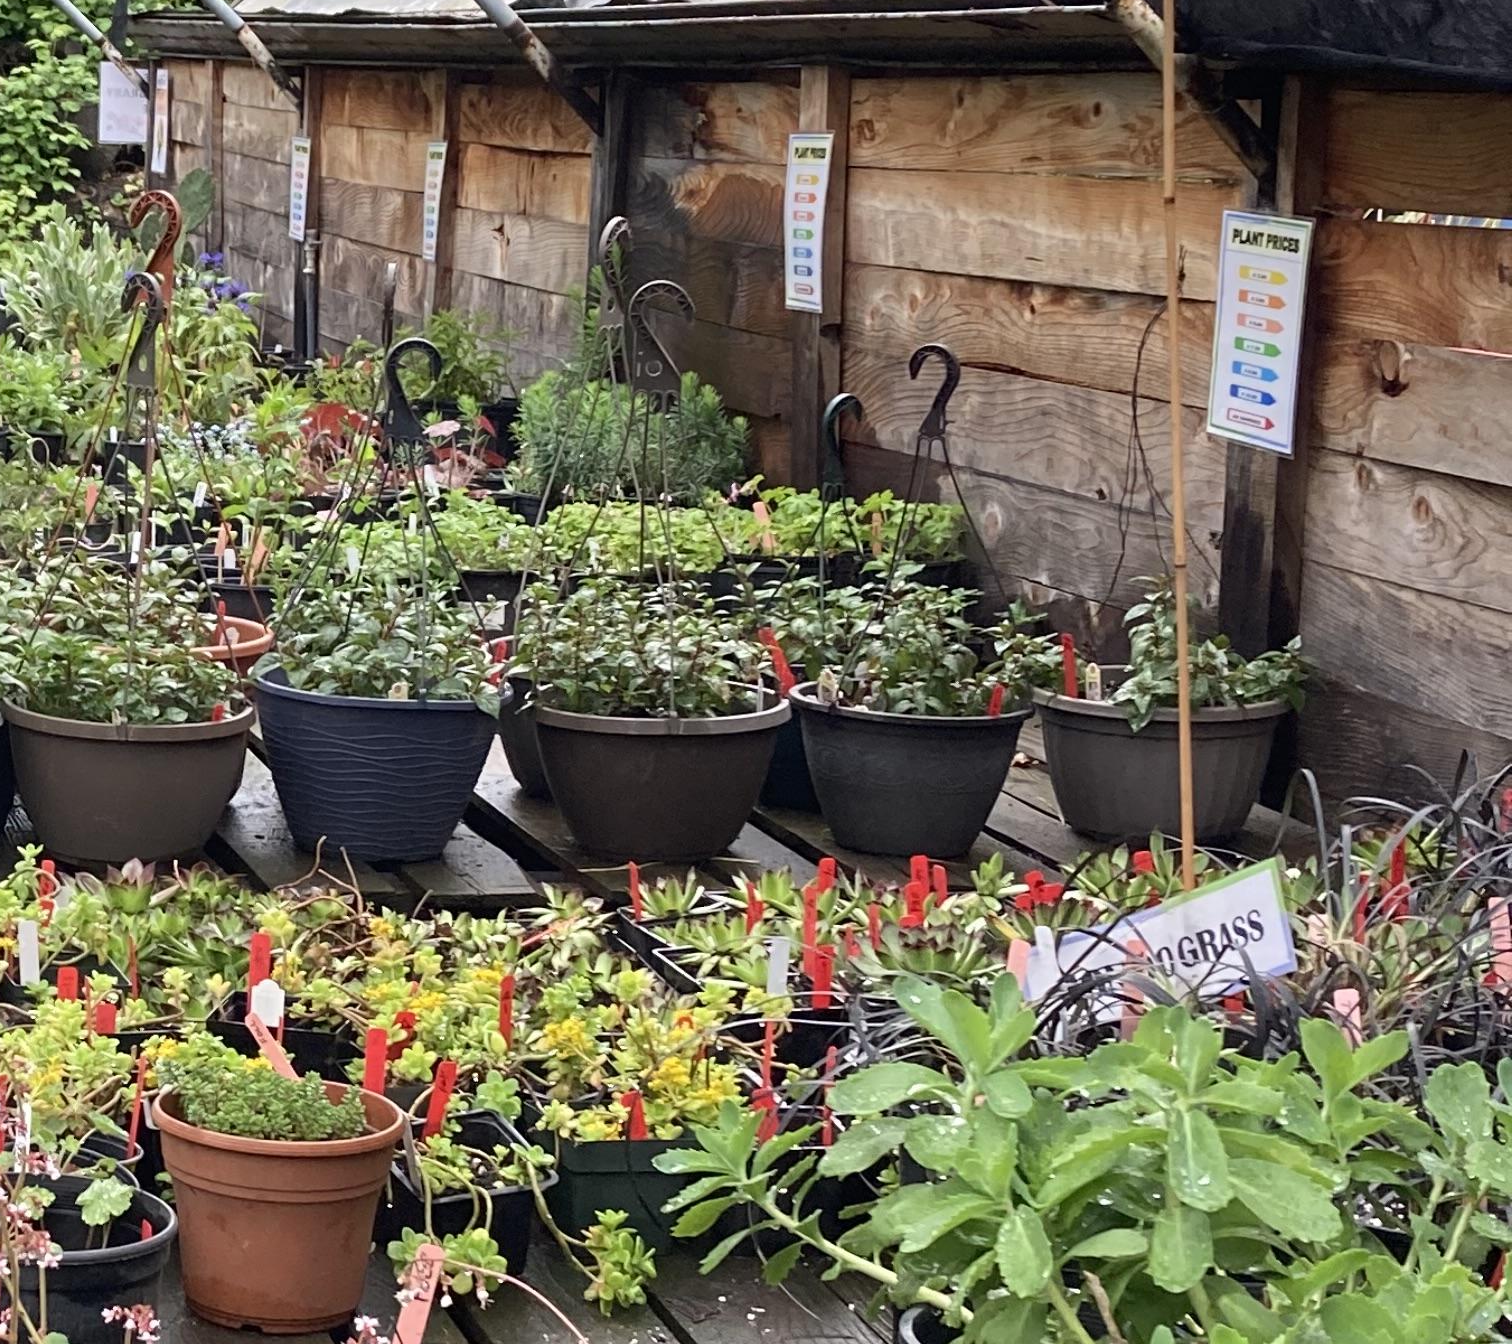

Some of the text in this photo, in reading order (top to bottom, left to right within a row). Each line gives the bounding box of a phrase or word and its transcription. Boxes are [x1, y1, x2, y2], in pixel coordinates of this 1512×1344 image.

[1231, 227, 1301, 254] PLANT PRICES
[1178, 909, 1265, 968] GRASS
